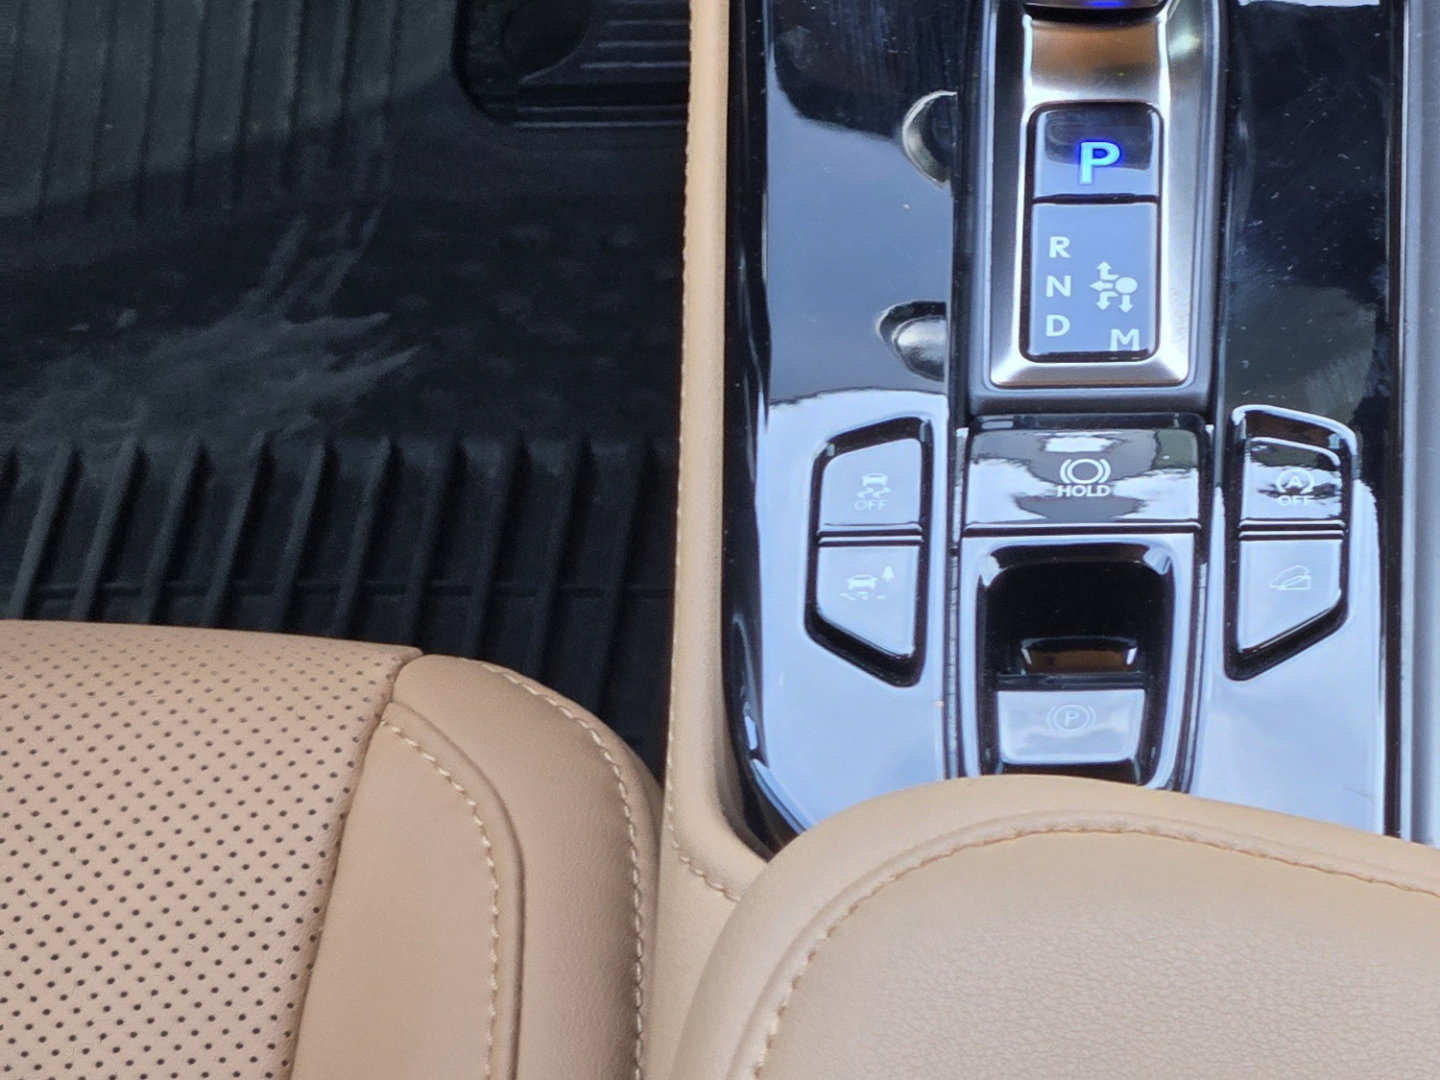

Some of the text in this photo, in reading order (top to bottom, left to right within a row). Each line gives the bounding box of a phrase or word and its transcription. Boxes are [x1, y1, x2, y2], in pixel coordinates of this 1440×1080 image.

[1079, 141, 1121, 184] P
[1049, 236, 1071, 258] R
[1046, 275, 1071, 297] N
[1046, 314, 1070, 337] D
[1109, 328, 1140, 352] M
[1057, 484, 1111, 497] HOLD
[1279, 494, 1315, 507] OFF
[854, 499, 889, 511] OFF
